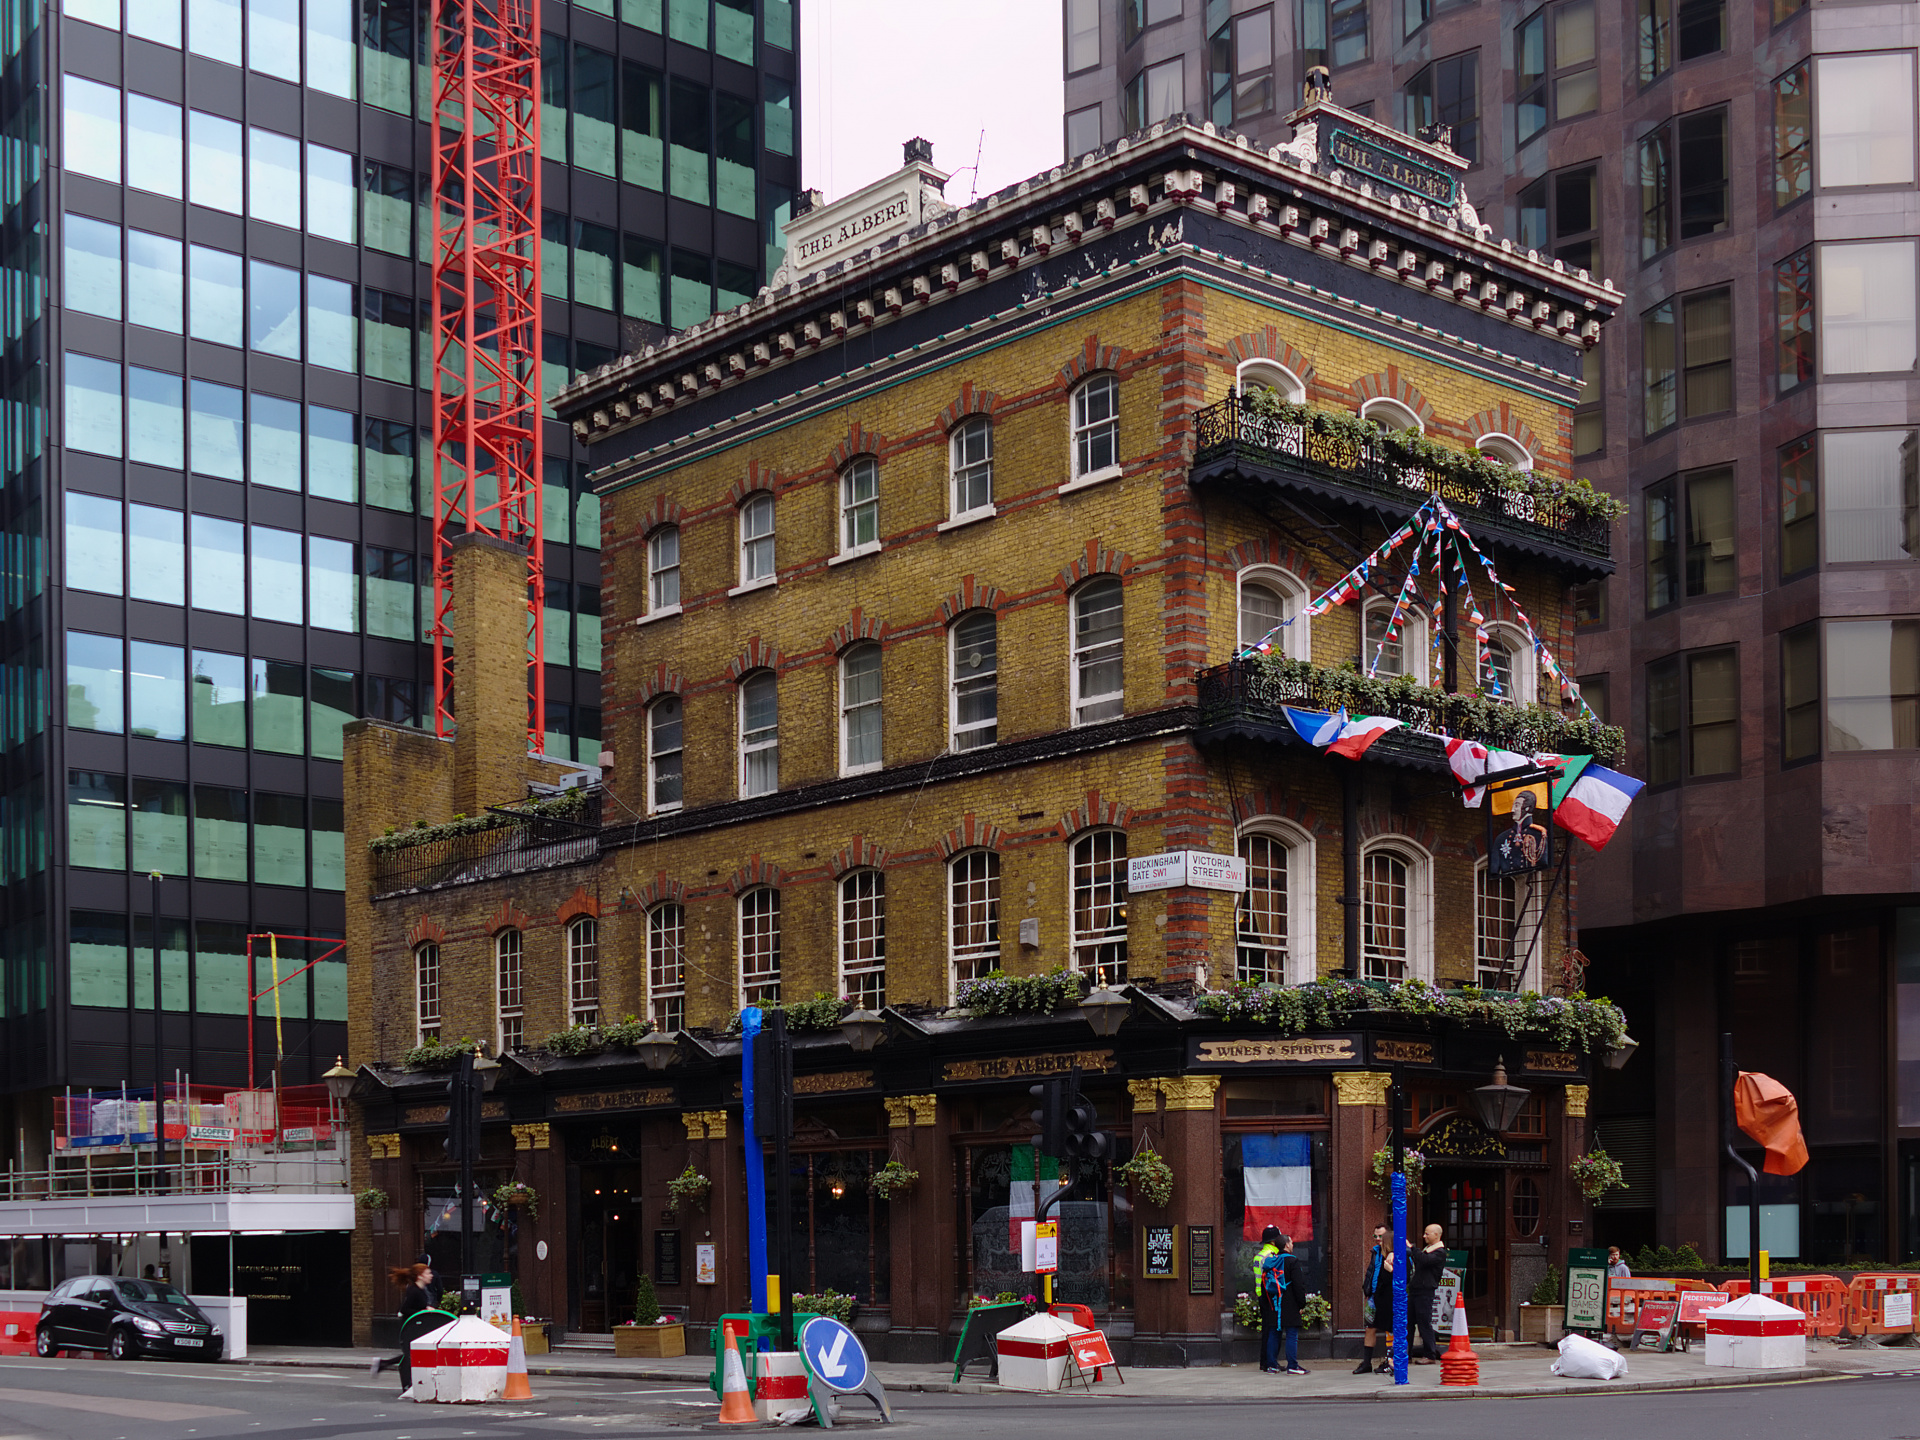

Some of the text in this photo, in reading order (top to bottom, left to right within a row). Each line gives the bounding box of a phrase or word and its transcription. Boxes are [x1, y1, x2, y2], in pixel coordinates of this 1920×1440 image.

[799, 199, 908, 260] THE ALBERT
[1132, 855, 1181, 871] BUCKINGHAM
[1192, 855, 1231, 868] VICTORIA
[1132, 868, 1167, 881] GATE SW1
[1192, 866, 1242, 880] STREET SW1
[1207, 881, 1234, 889] WESTMINSTER
[1216, 1044, 1335, 1057] WINES & SPIRITS
[978, 1054, 1078, 1076] THE ALBERT
[589, 1135, 620, 1152] ALBERT
[1150, 1233, 1172, 1242] LIVE
[1147, 1241, 1173, 1250] SPORT
[1151, 1254, 1168, 1267] sky
[236, 1265, 302, 1273] BUCKINGHAM GREEN
[1572, 1282, 1600, 1301] BIG
[1571, 1300, 1598, 1310] GAMES
[1684, 1294, 1725, 1303] PEDESTRIANS
[1071, 1335, 1103, 1347] PEDESTRIANS
